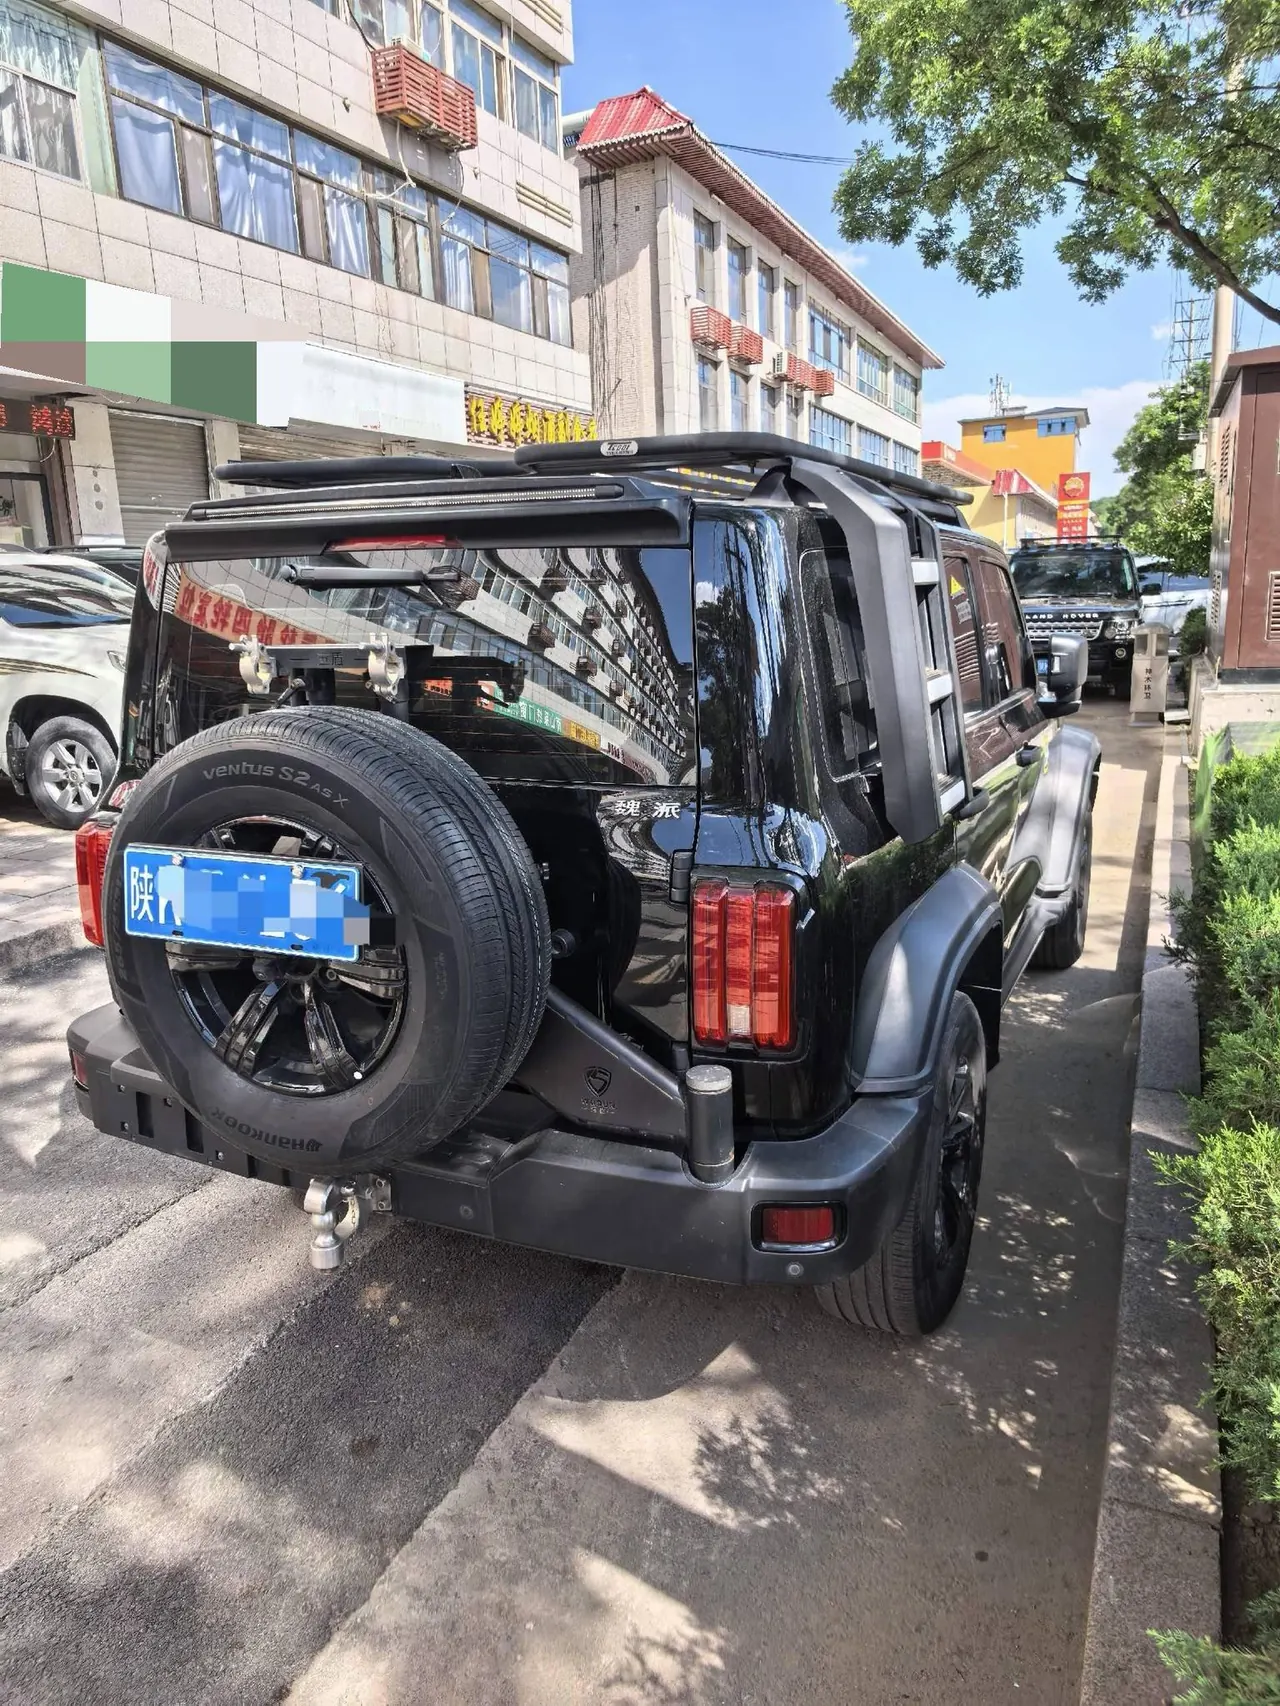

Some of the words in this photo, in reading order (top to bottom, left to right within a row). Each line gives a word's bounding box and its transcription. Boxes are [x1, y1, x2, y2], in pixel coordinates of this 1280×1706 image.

[278, 766, 312, 786] S2
[310, 783, 333, 798] AS
[332, 793, 349, 809] X
